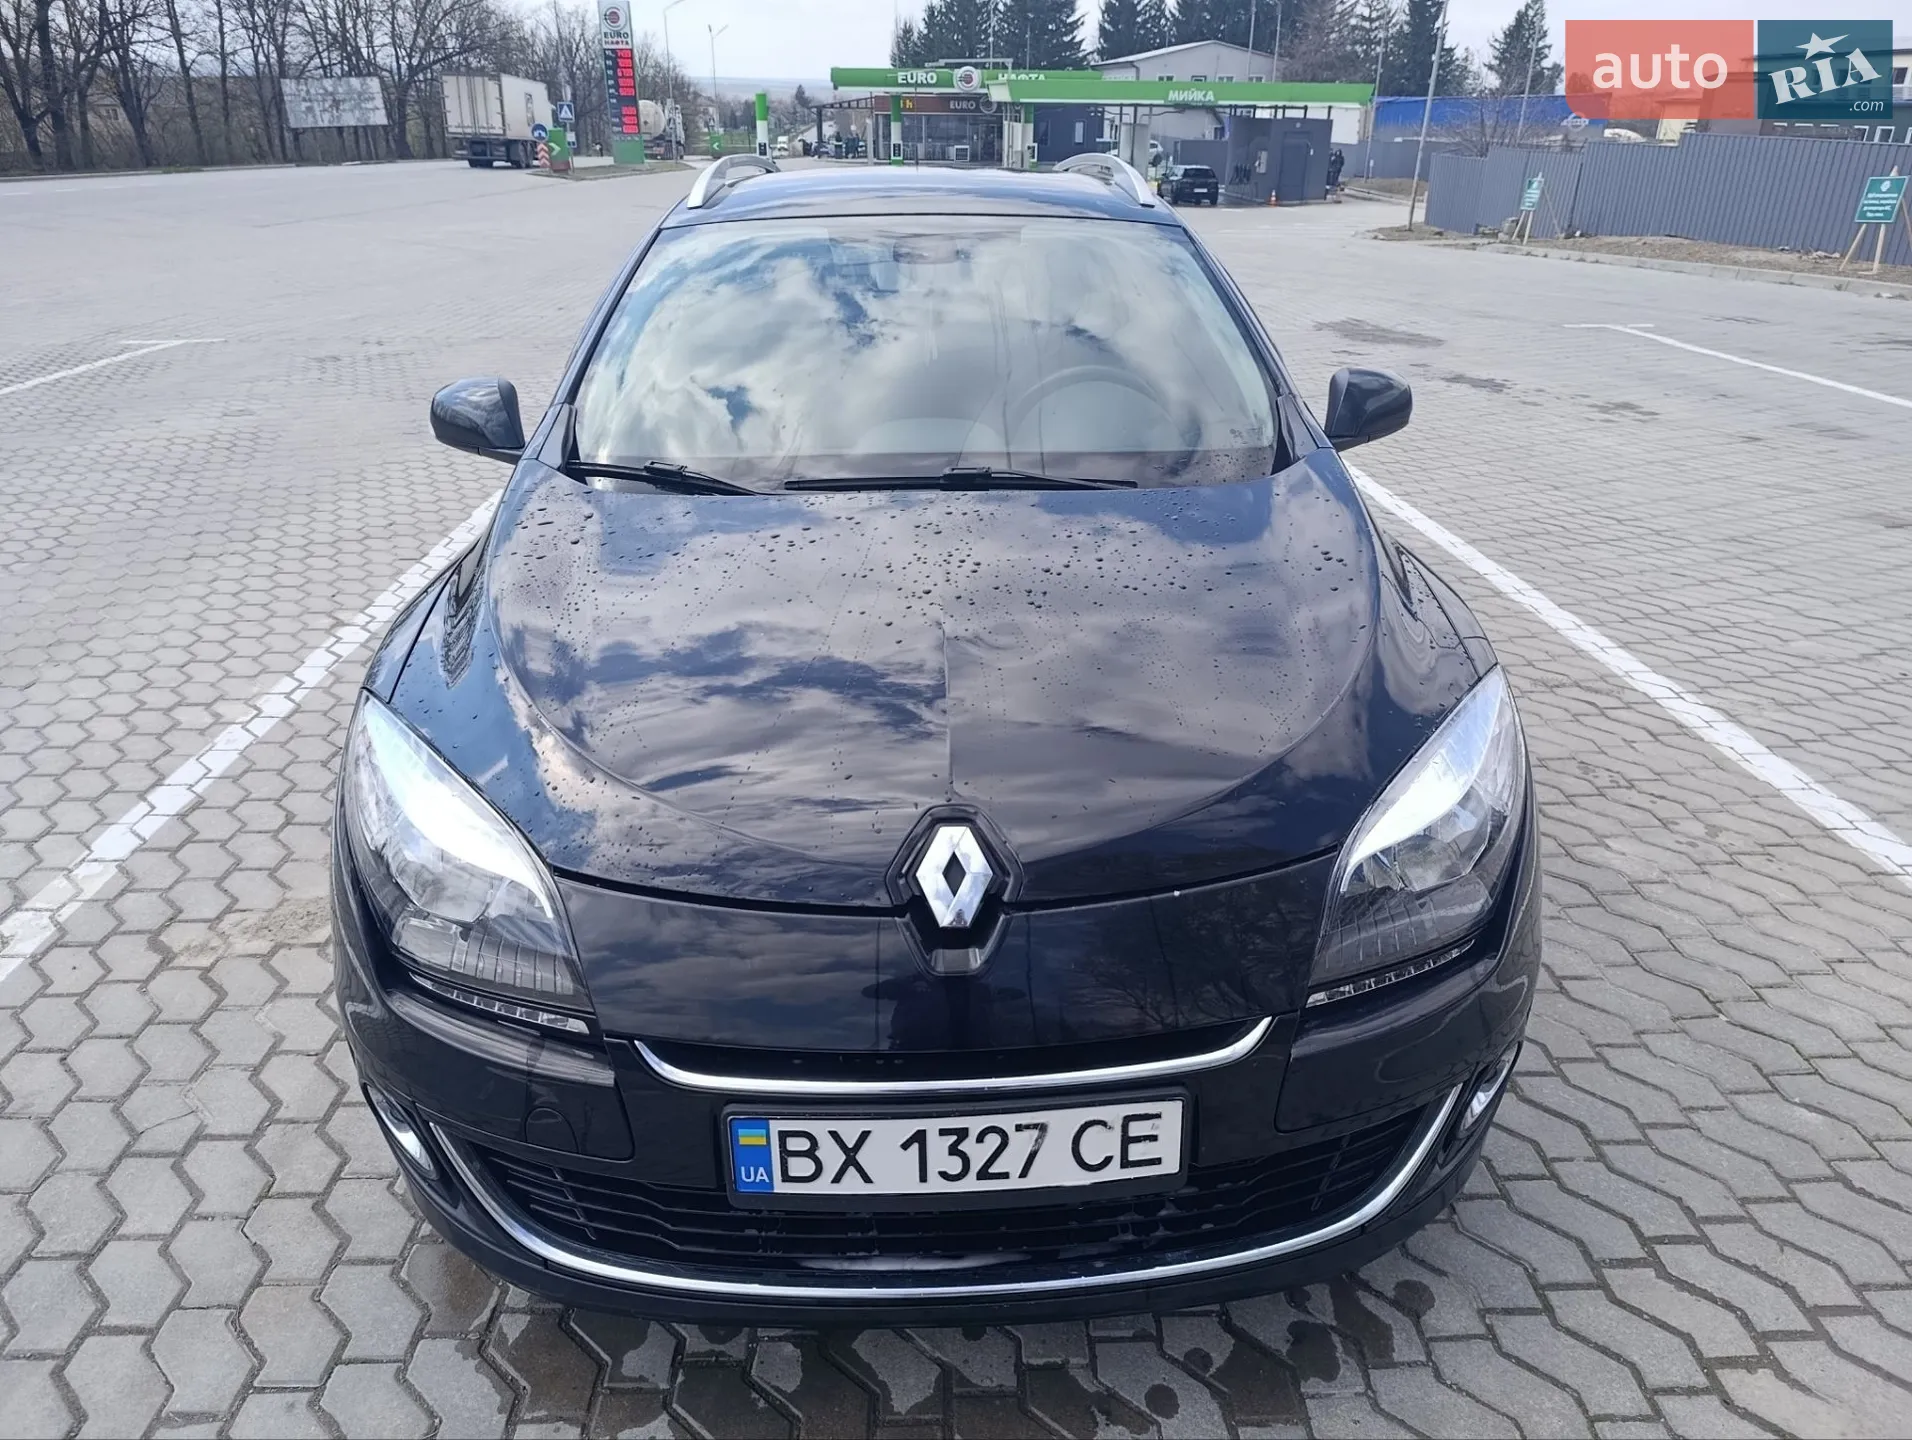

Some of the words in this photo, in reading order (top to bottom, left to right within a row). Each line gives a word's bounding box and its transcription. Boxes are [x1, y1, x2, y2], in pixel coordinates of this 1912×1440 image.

[603, 31, 629, 39] EURO
[897, 71, 938, 84] EURO
[1168, 88, 1215, 102] МИЙКА
[949, 101, 976, 110] EURO
[777, 1129, 874, 1184] BX
[899, 1122, 1049, 1183] 1327
[1071, 1112, 1163, 1173] CE
[741, 1166, 769, 1183] UA
